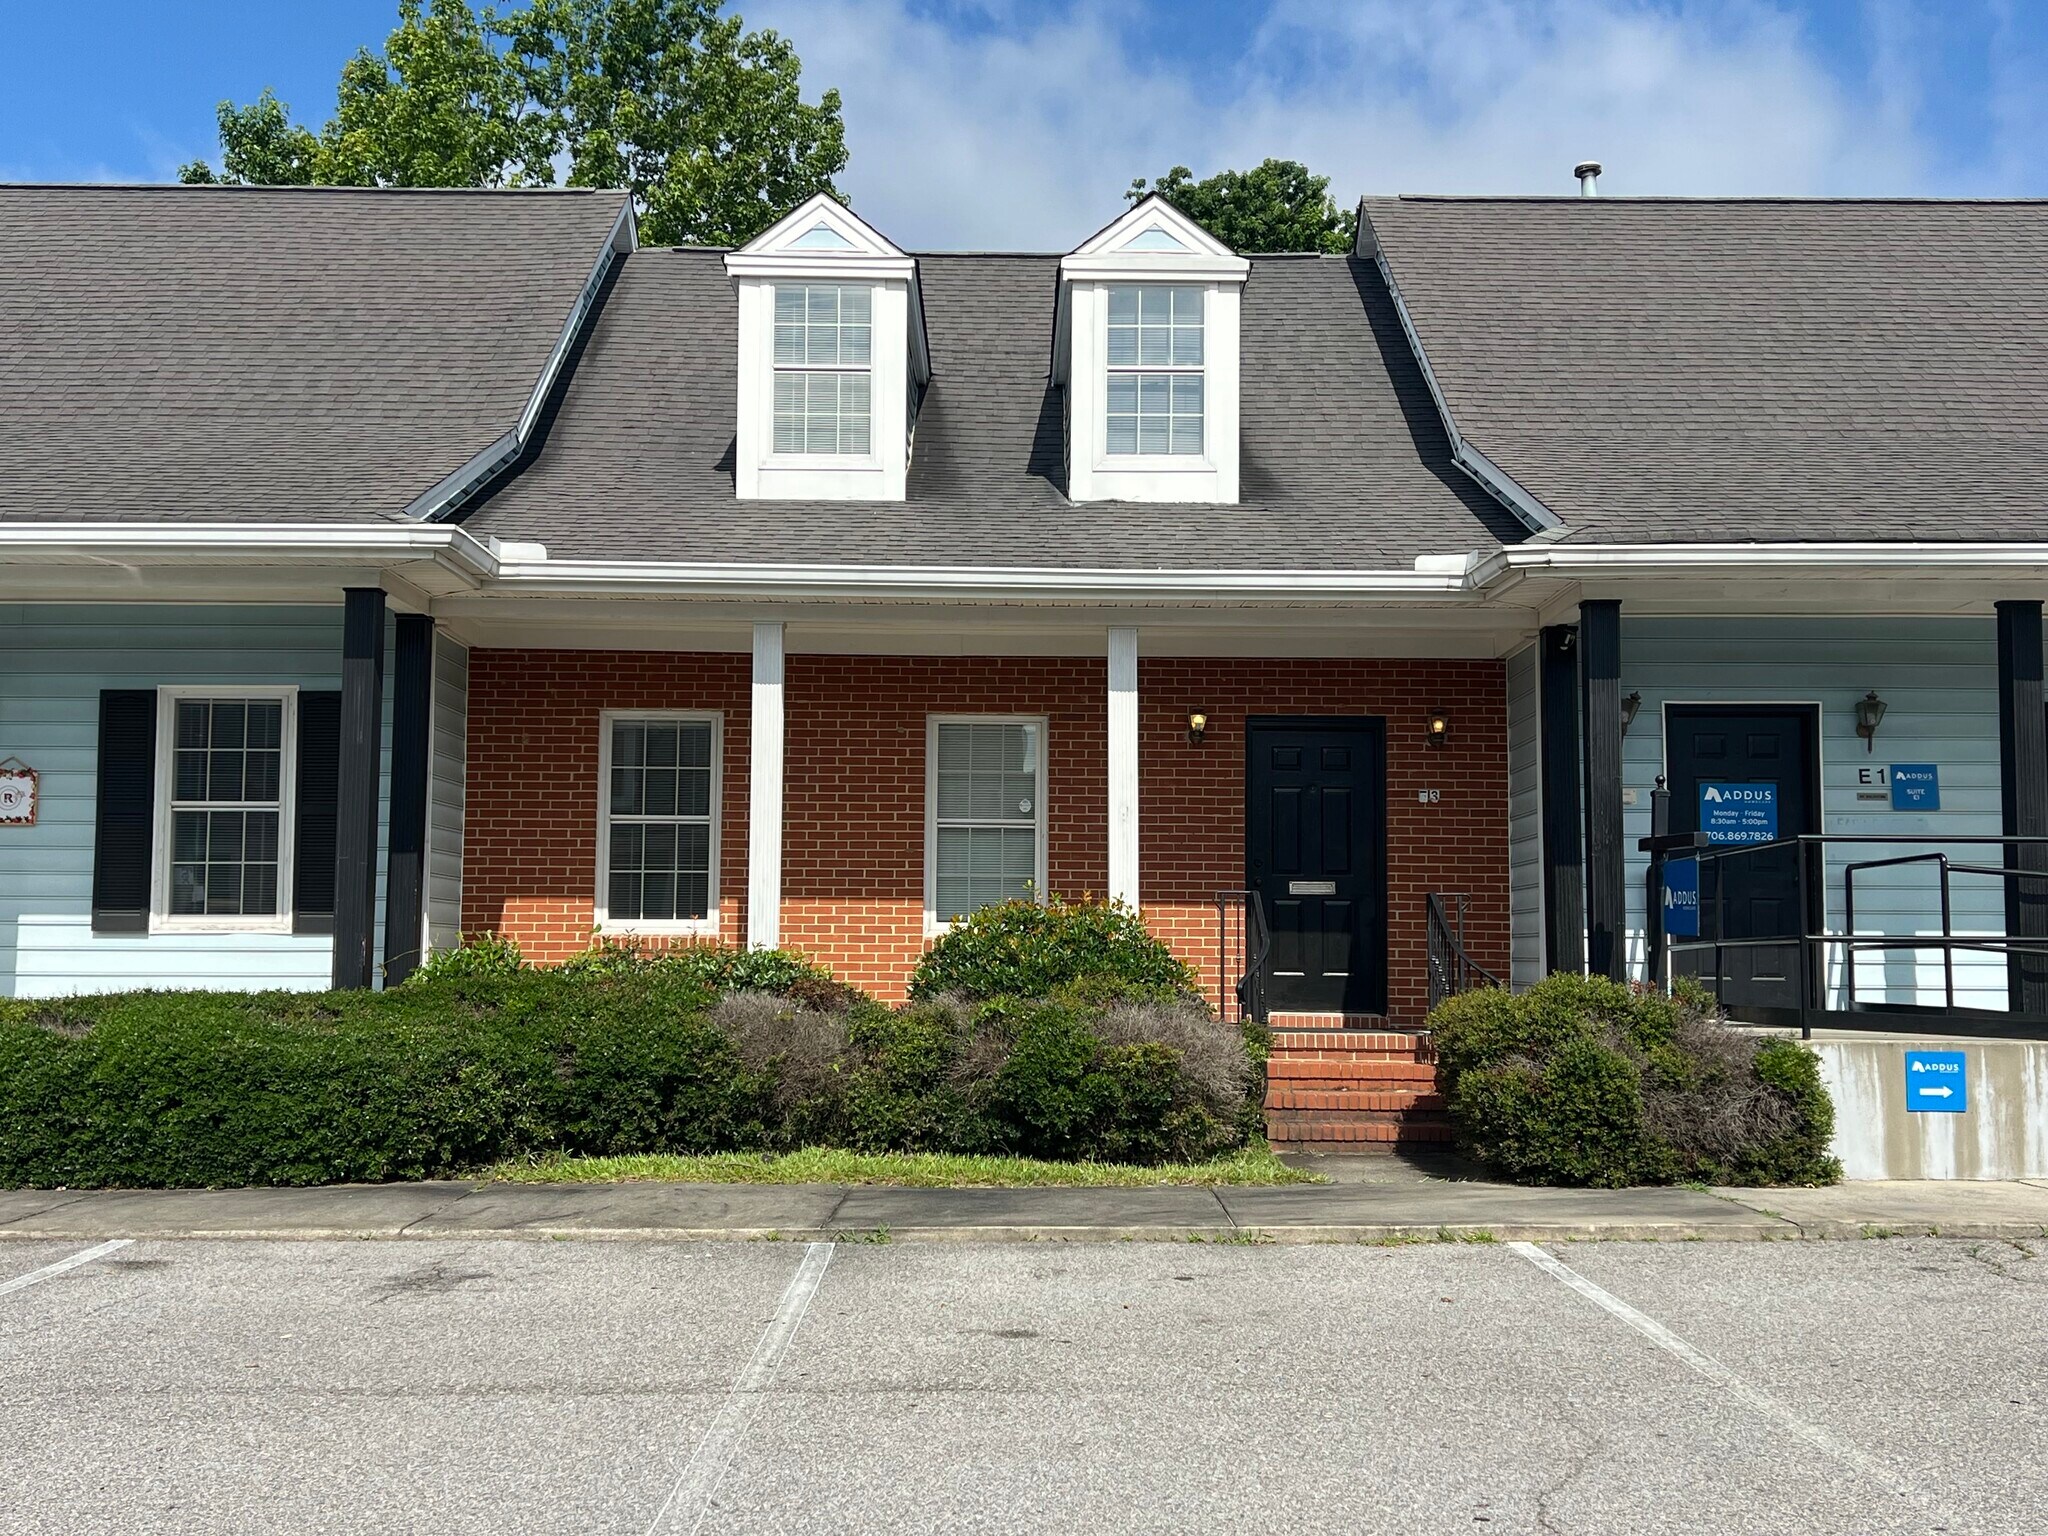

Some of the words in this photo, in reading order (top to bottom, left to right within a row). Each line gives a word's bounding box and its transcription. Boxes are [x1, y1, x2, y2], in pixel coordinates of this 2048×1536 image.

[1859, 769, 1885, 784] E1
[4, 793, 14, 803] R
[1431, 790, 1438, 801] 3
[1723, 790, 1772, 800] ADDUS
[1744, 810, 1766, 818] Friday
[1742, 818, 1769, 826] 5:00pm
[1705, 831, 1774, 841] 706.869.7826
[1673, 890, 1697, 905] ADDUS
[1924, 1063, 1959, 1071] ADDUS
